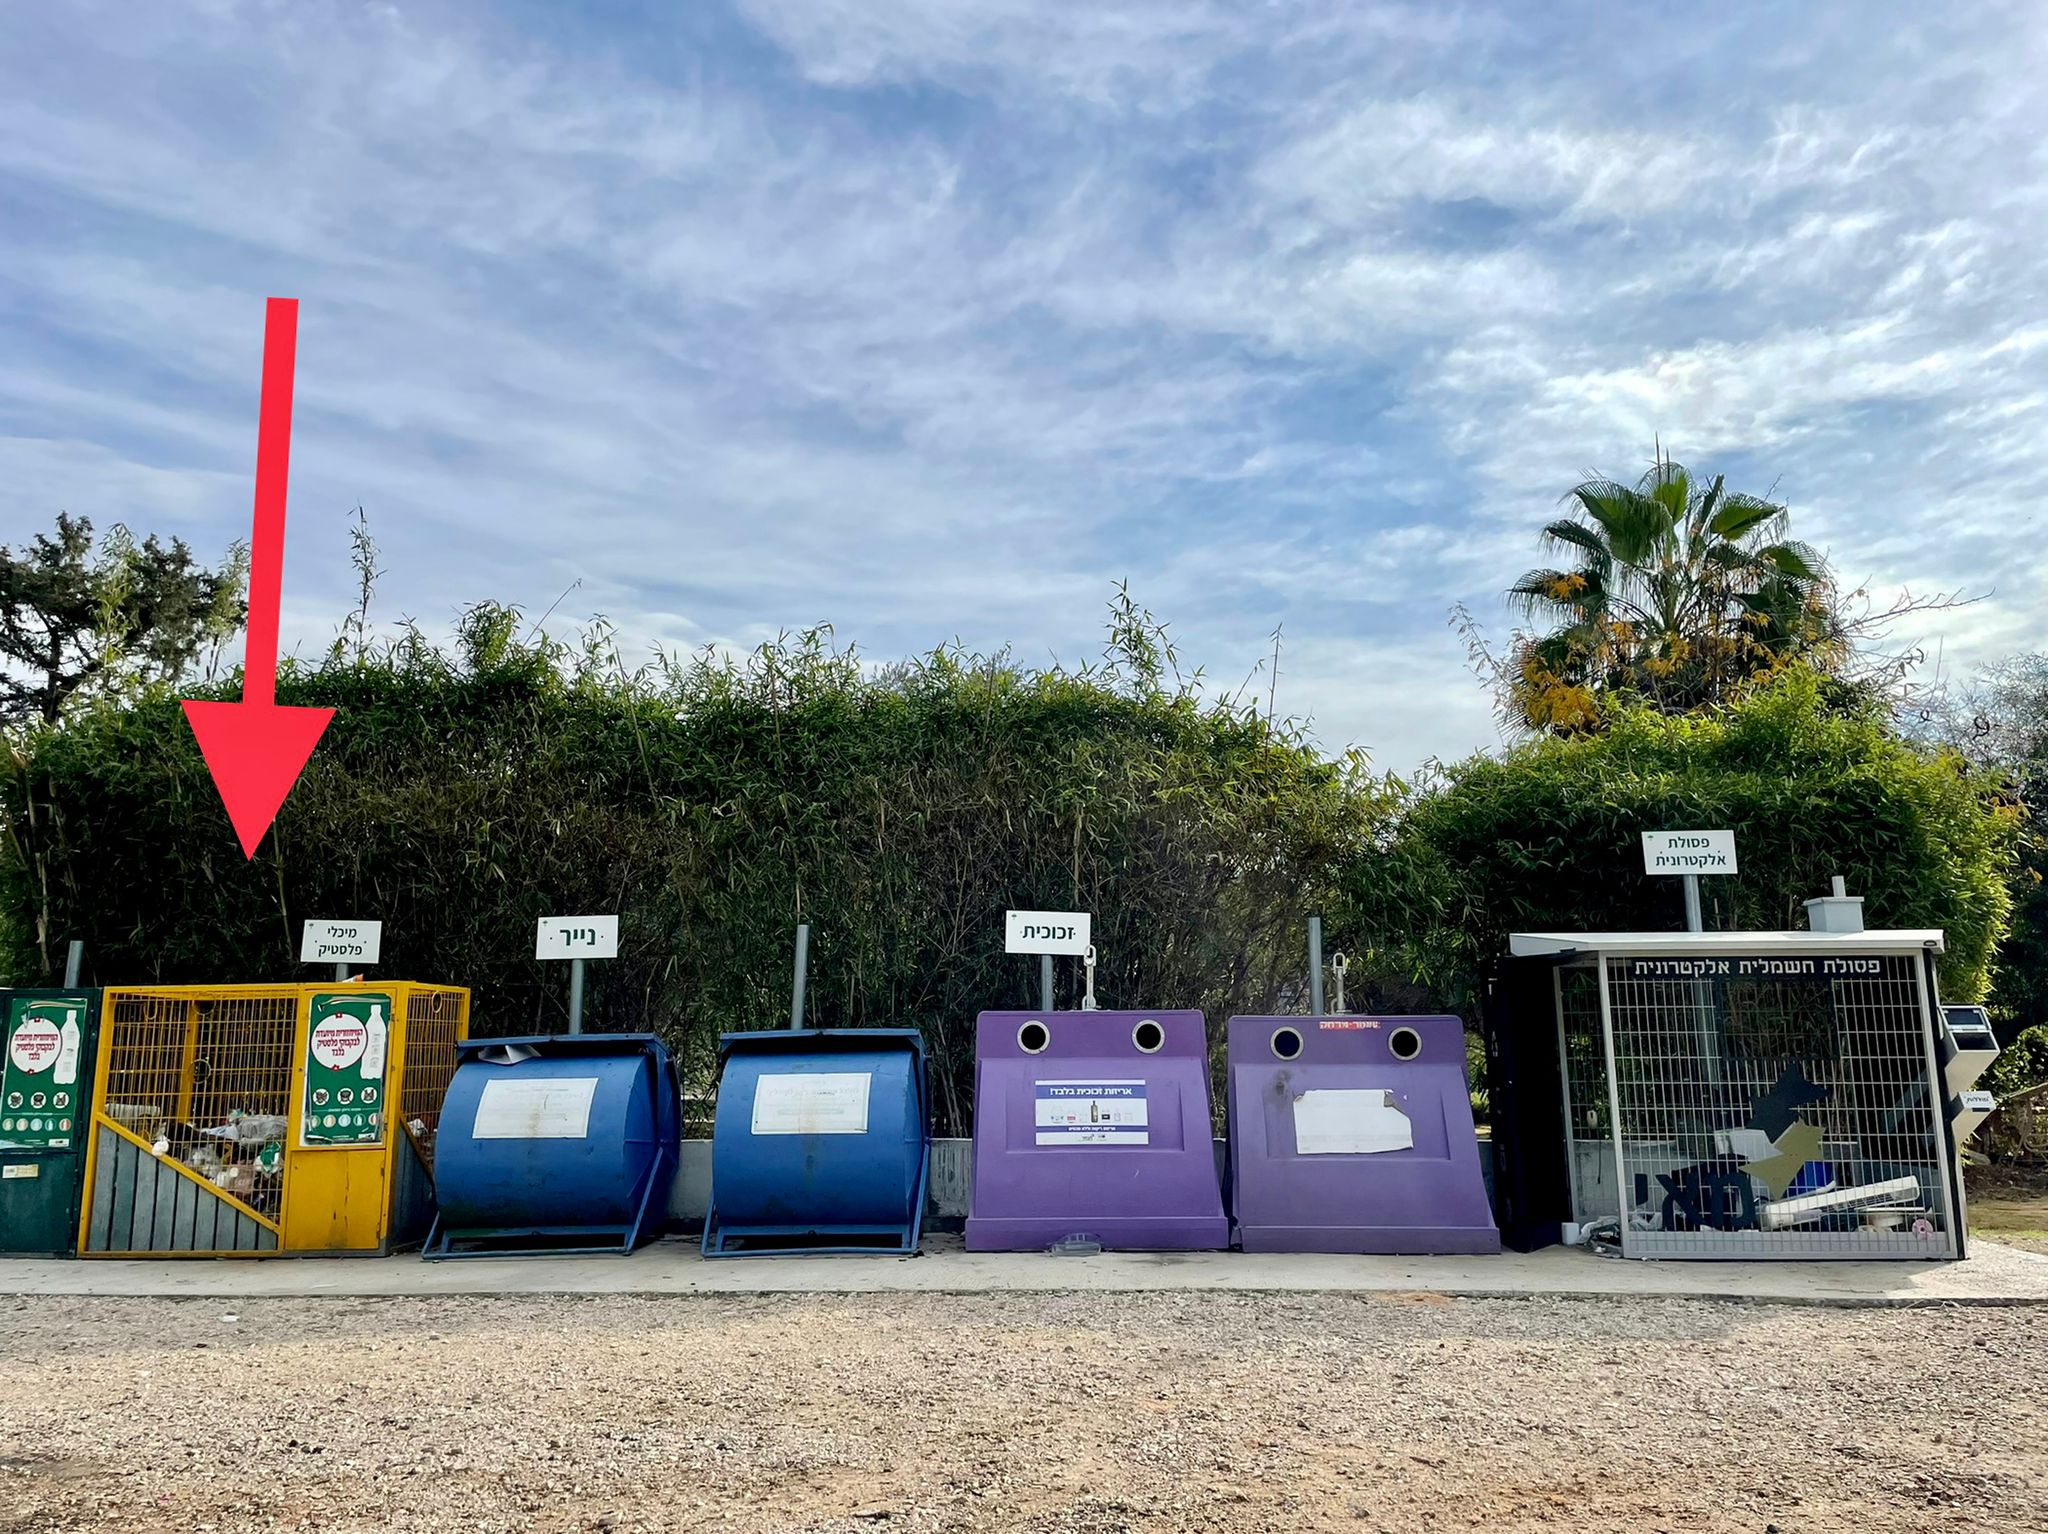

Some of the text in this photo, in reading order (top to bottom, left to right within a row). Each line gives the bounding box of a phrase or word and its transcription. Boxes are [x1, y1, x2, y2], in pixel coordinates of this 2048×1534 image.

[1668, 836, 1710, 849] פסולת
[1656, 853, 1727, 868] אלקטרונית
[327, 926, 357, 938] מיכלי
[560, 928, 596, 946] נייר
[1022, 925, 1074, 940] זכוכית
[318, 943, 363, 958] פלסטיק
[1635, 959, 1881, 978] פסולת חשמלית אלקטרונית
[331, 1047, 345, 1057] בלבד
[1050, 1087, 1133, 1096] אריזות זכוכית בלבד!
